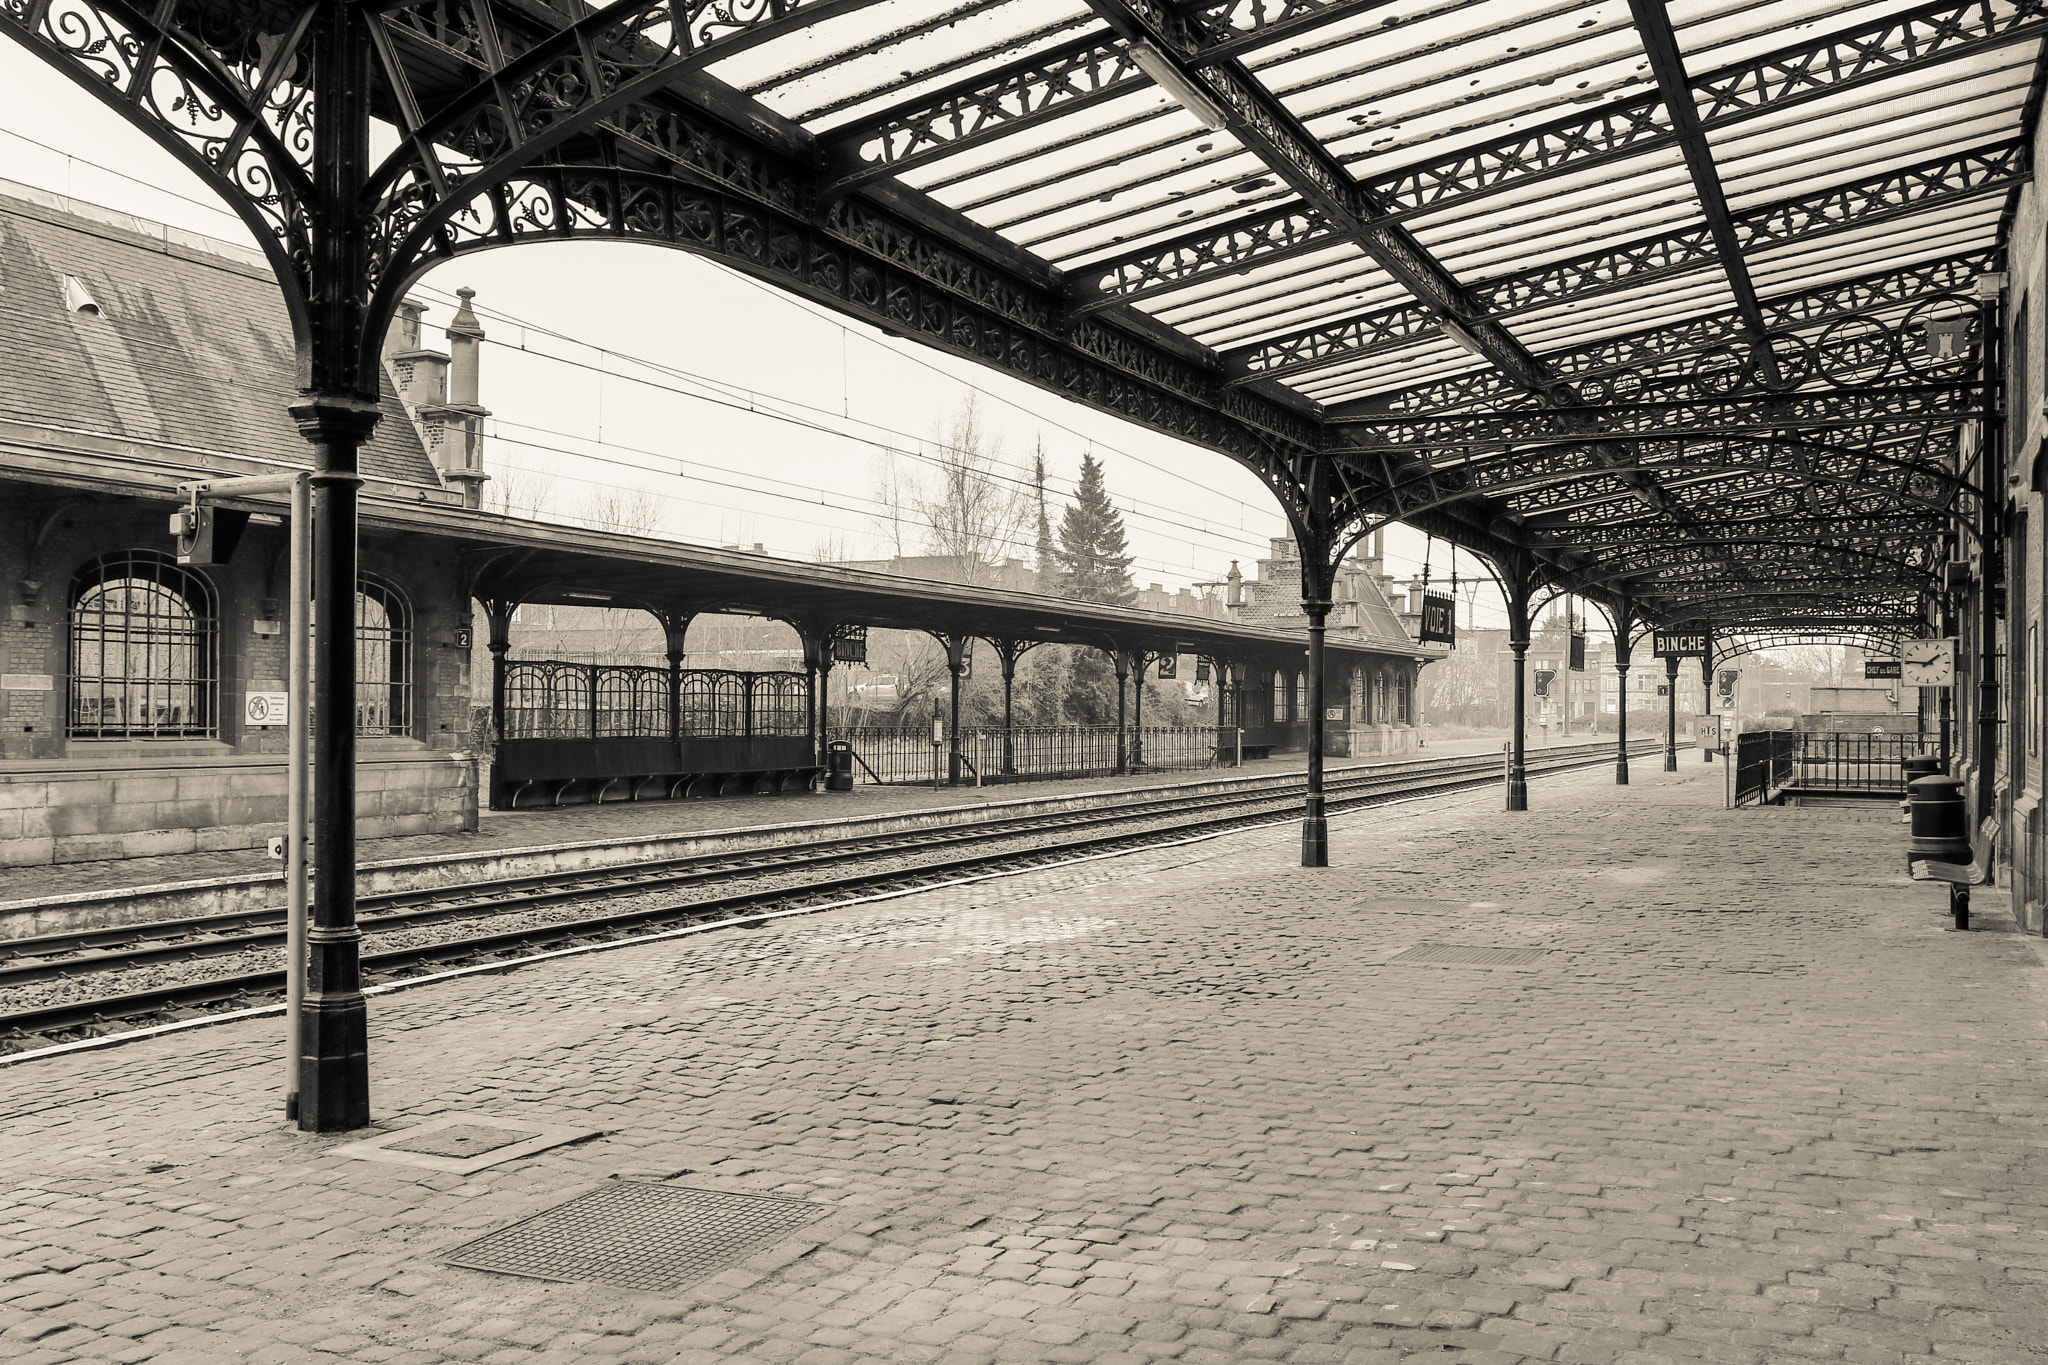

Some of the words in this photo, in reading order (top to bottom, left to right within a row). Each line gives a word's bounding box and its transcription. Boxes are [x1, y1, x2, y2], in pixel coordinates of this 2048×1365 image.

[1425, 604, 1445, 634] VOIE
[1447, 609, 1452, 635] 1
[460, 633, 468, 646] 2
[1656, 635, 1706, 652] BINCHE
[836, 640, 865, 658] BINCHE
[1160, 656, 1175, 676] 2
[1866, 666, 1880, 674] CHEF
[1886, 666, 1900, 674] GARE
